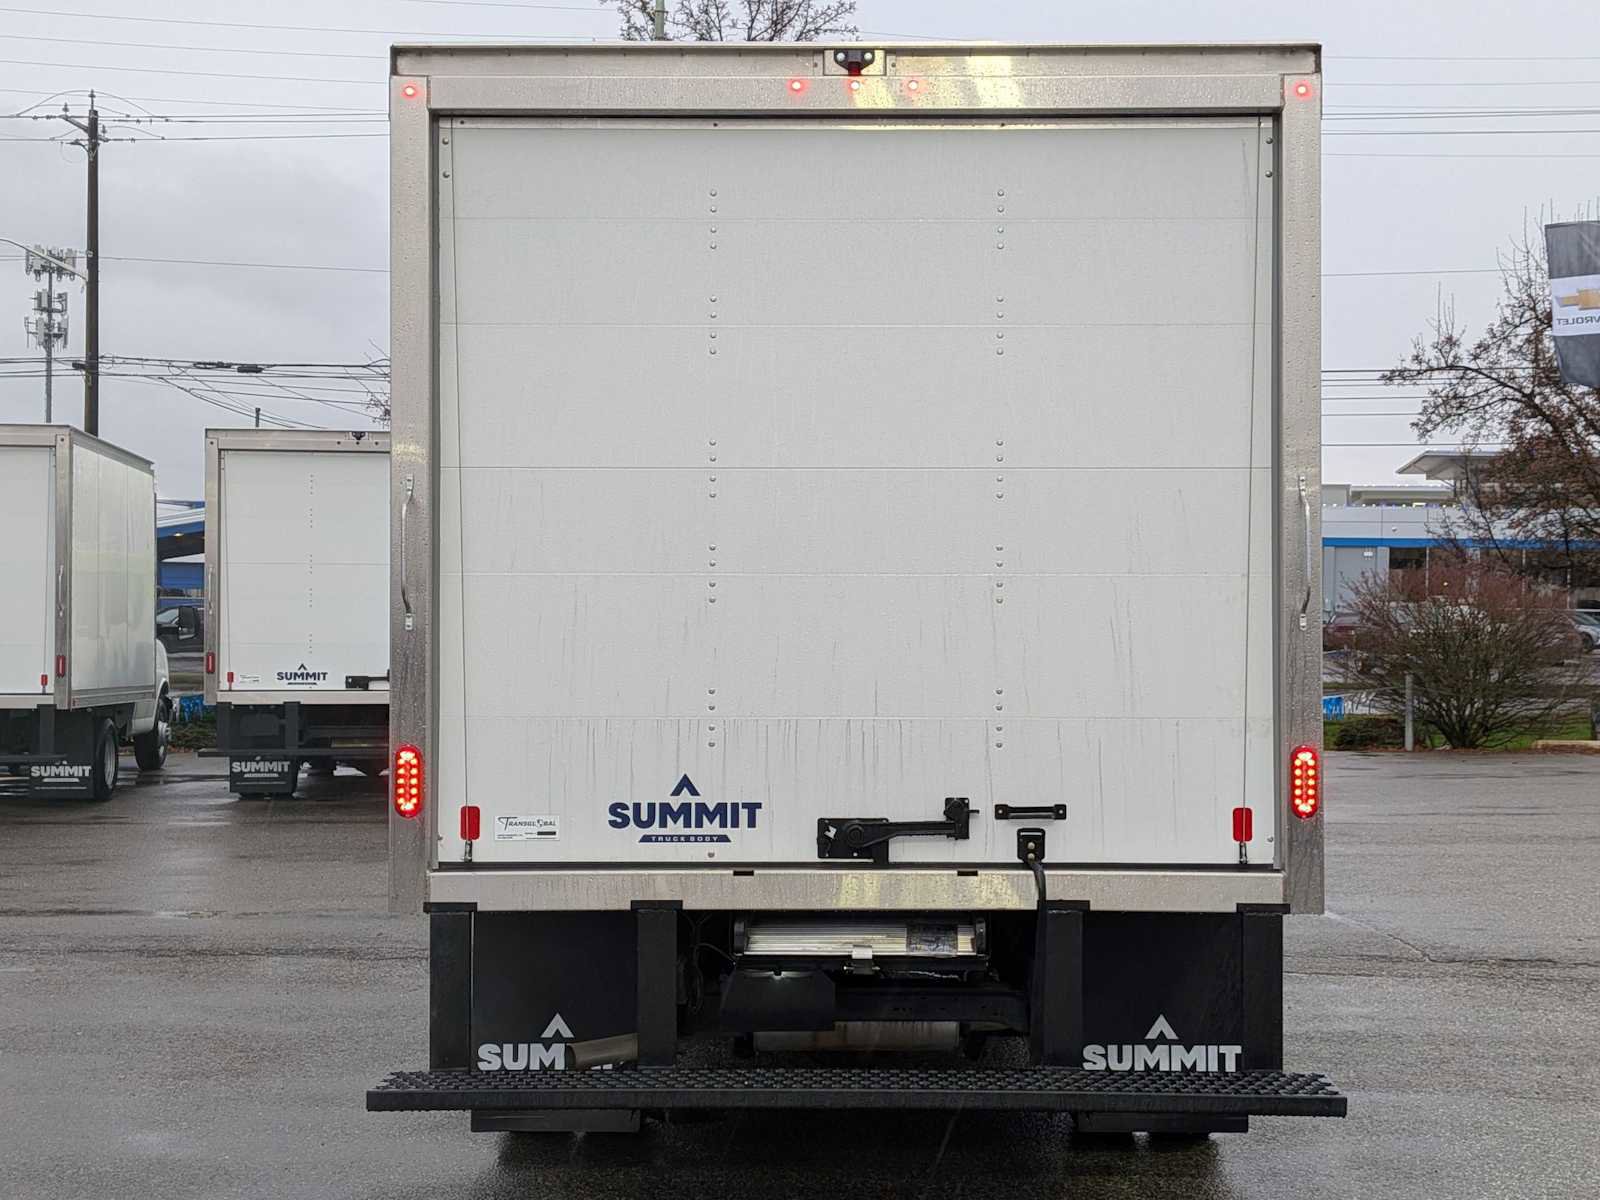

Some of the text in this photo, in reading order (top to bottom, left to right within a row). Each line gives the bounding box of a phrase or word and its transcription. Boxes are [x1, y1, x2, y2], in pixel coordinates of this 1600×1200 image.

[276, 672, 328, 681] SUMMIT
[31, 766, 92, 777] SUMMIT
[231, 761, 290, 772] SUMMIT
[608, 802, 762, 829] SUMMIT
[477, 1043, 624, 1071] SUM
[1082, 1044, 1242, 1073] SUMMIT
